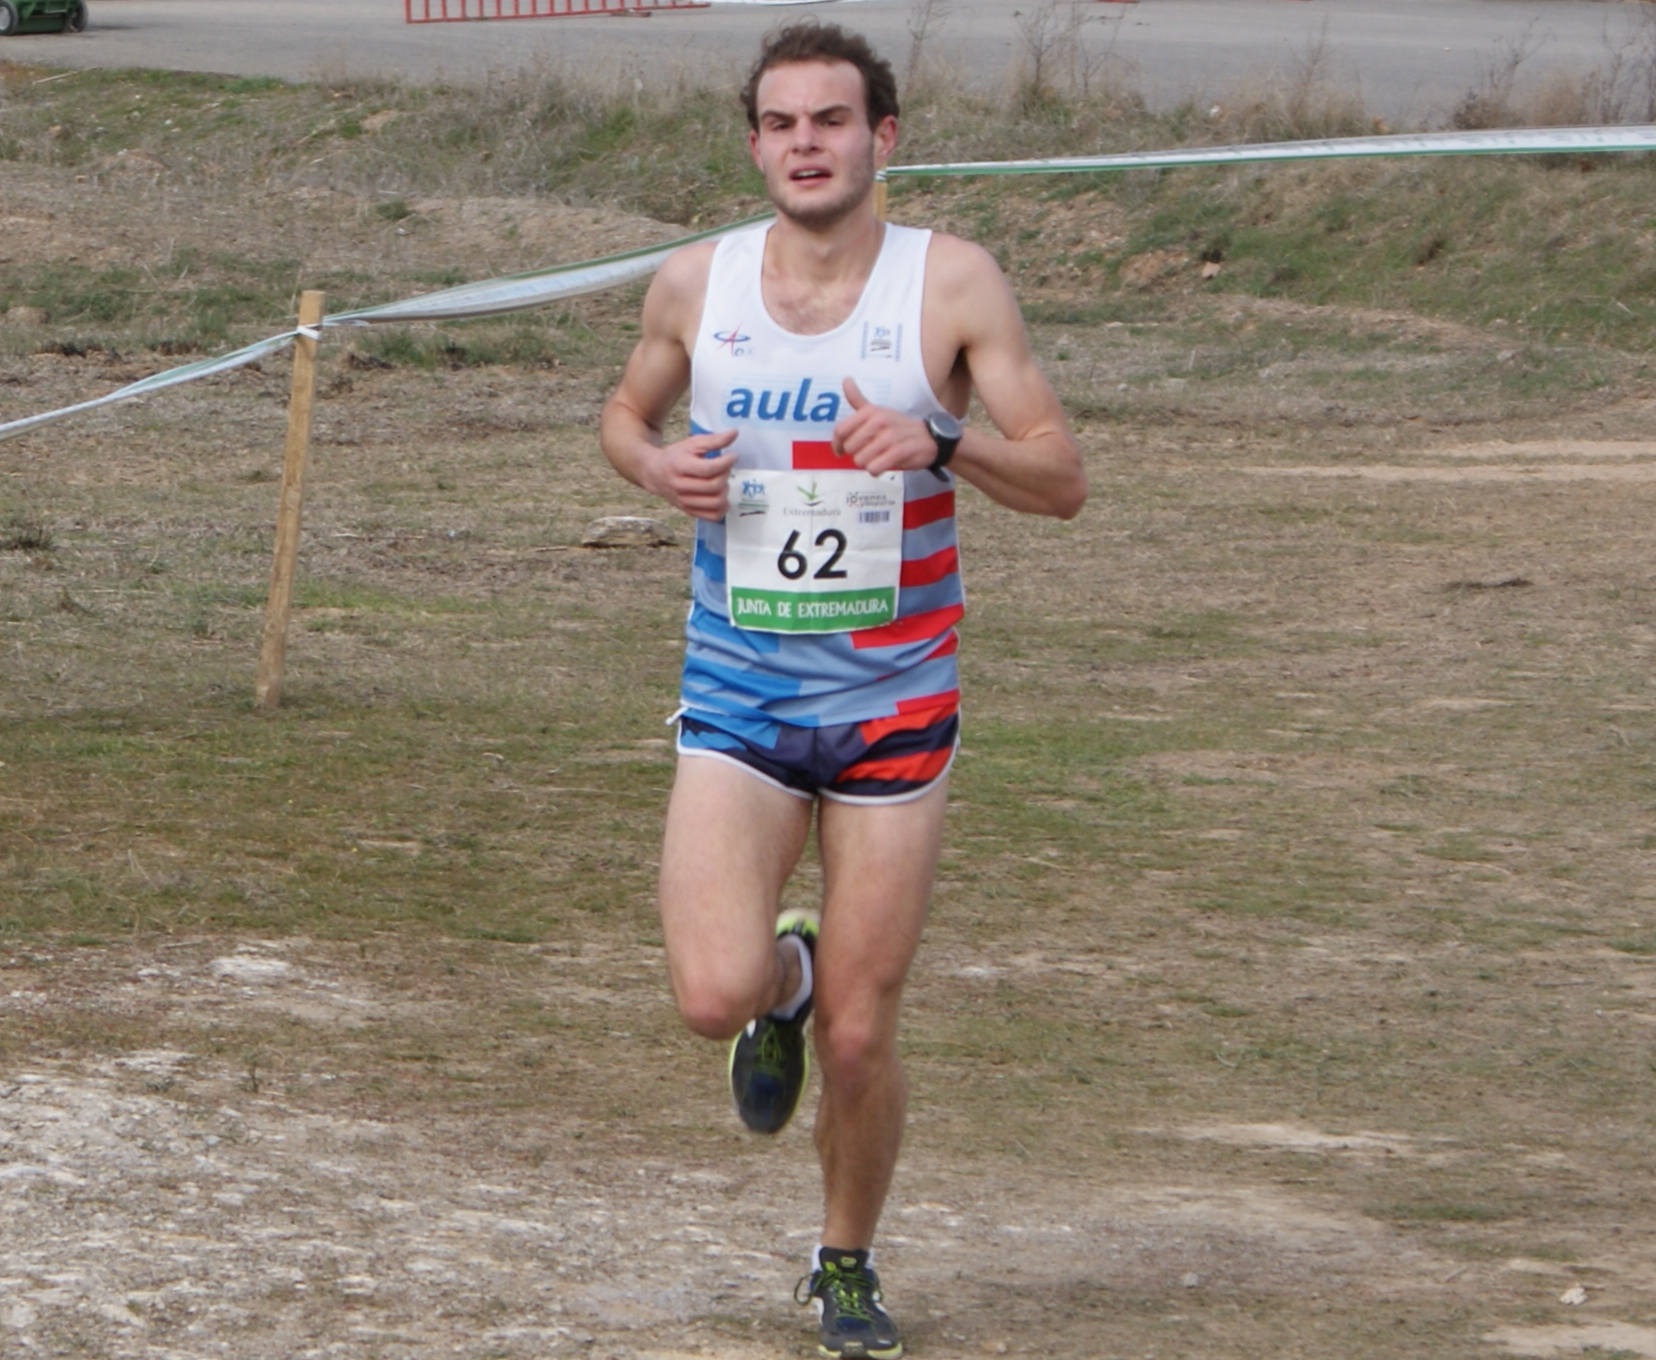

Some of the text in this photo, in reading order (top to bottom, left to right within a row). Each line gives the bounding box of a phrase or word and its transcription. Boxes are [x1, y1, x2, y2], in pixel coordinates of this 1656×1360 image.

[726, 377, 841, 422] aula
[777, 528, 848, 580] 62
[737, 597, 889, 618] JUNTA DE EXTREMADURA
